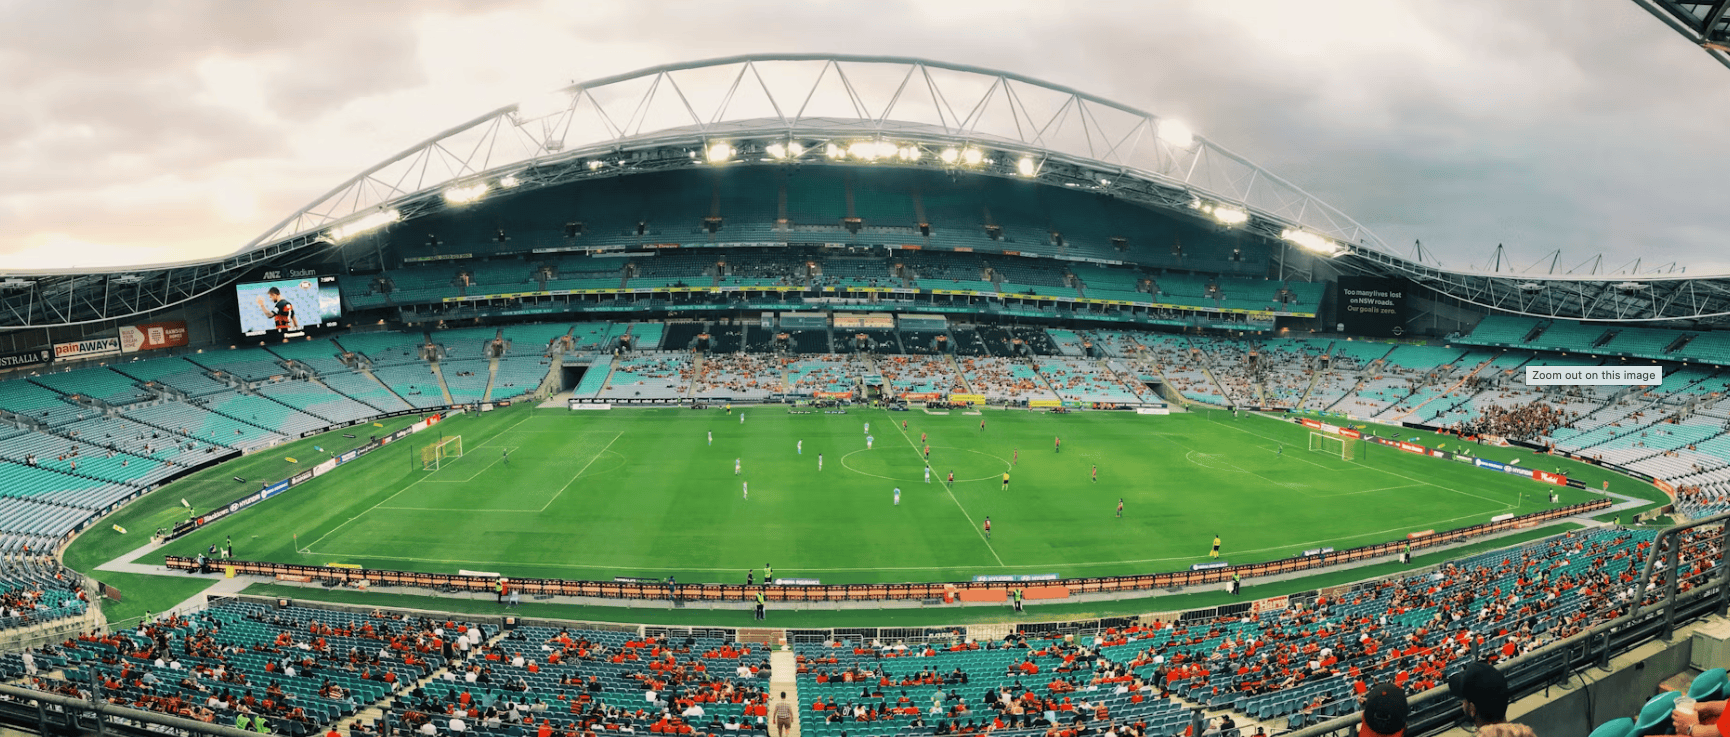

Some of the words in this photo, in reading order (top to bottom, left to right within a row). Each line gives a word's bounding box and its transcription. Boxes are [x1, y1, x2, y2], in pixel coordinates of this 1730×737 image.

[263, 270, 281, 280] ANZ
[290, 268, 316, 277] Stadium
[55, 340, 108, 356] painAWAY
[0, 354, 39, 366] STRALIA
[239, 494, 260, 507] HYUNDAI
